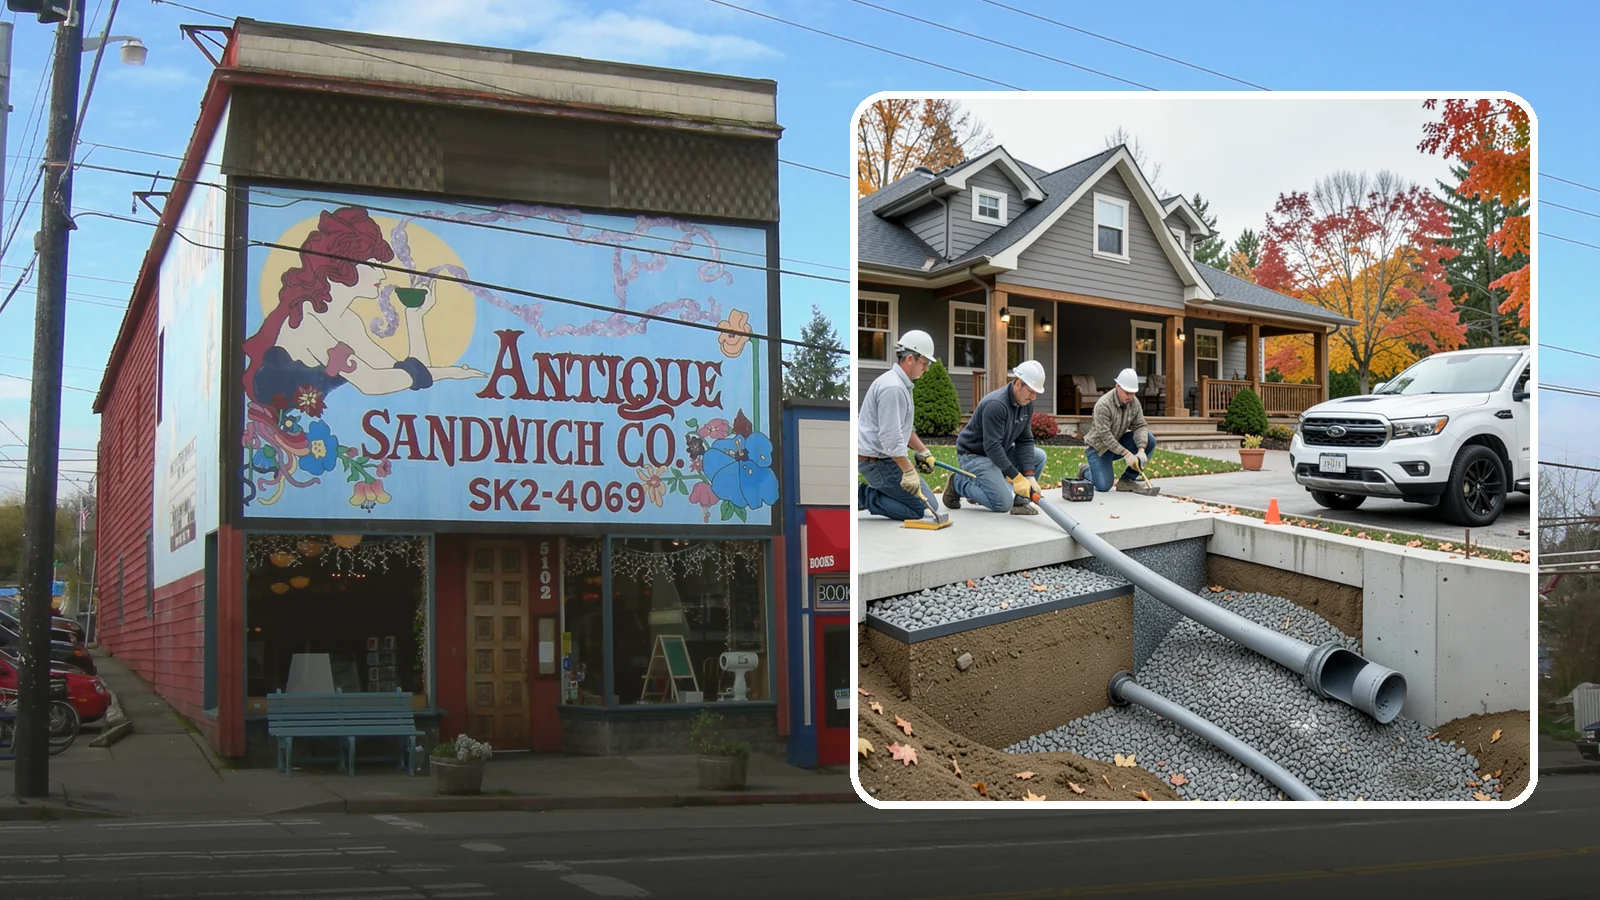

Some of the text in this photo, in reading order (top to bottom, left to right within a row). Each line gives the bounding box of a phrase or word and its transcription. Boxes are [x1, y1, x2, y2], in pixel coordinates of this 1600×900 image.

[476, 329, 723, 421] ANTIQUE
[361, 409, 685, 469] SANDWICH CO.
[468, 477, 646, 513] SK2-4069
[540, 542, 552, 599] 5102
[809, 555, 835, 569] BOOKS
